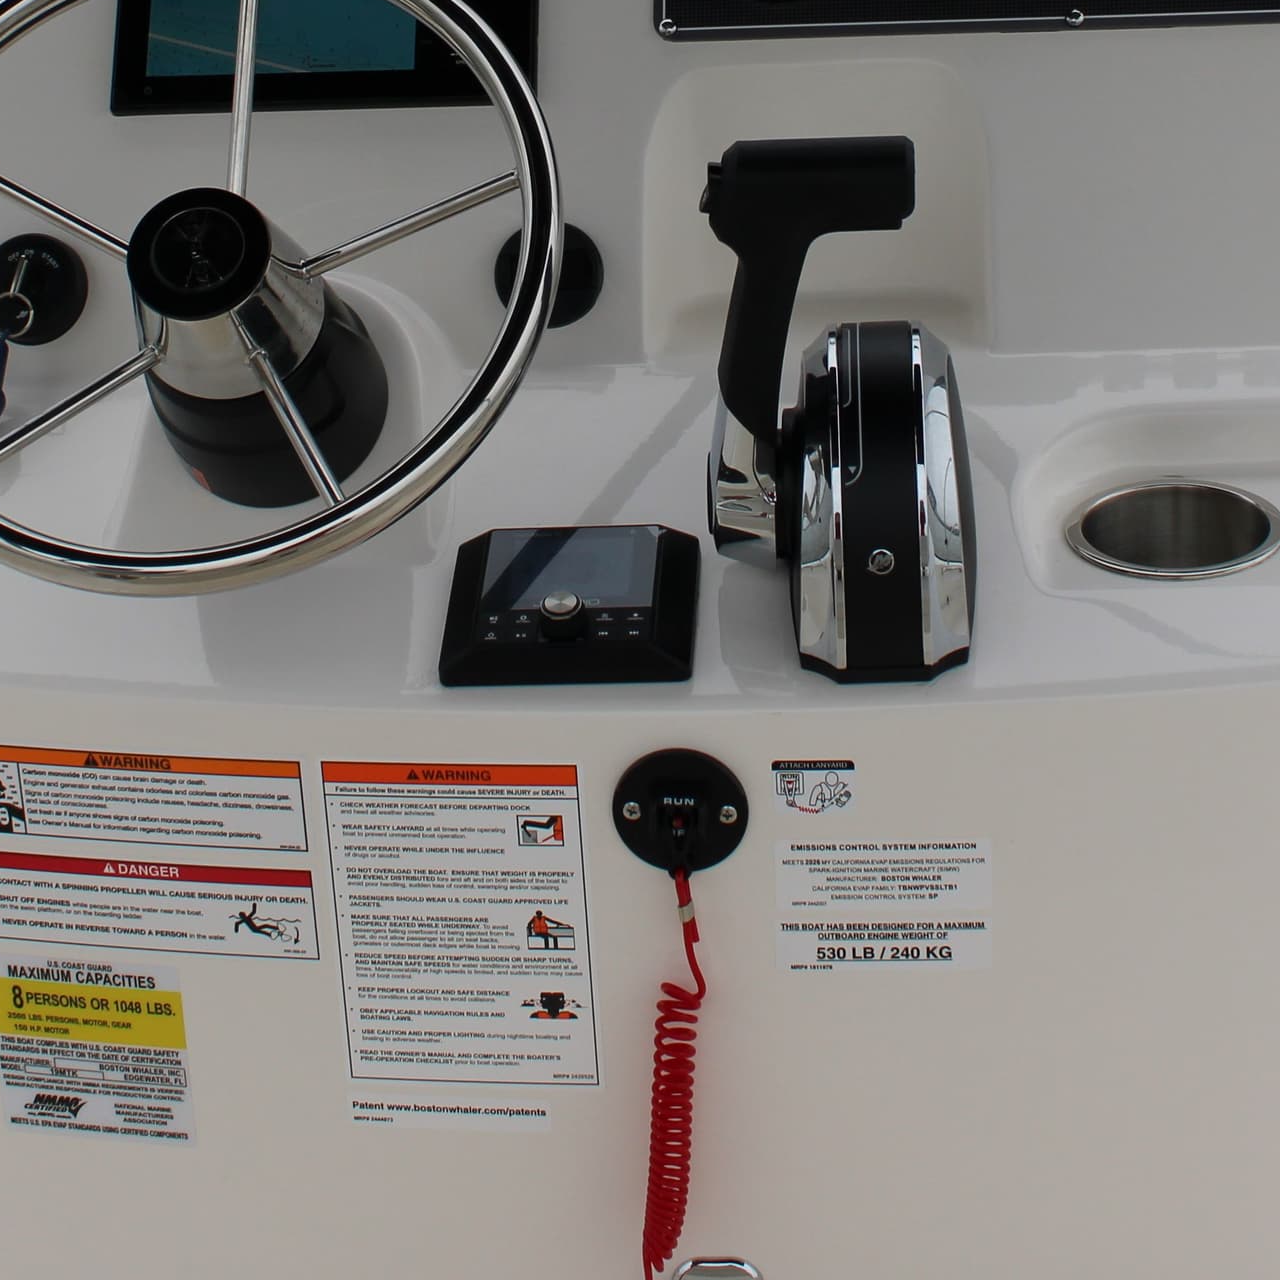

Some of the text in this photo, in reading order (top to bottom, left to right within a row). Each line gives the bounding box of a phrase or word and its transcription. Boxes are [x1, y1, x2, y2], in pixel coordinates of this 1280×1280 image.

[97, 755, 171, 771] WARNING
[421, 769, 491, 782] WARNING
[663, 796, 696, 806] RUN
[117, 863, 179, 879] DANGER
[32, 880, 53, 891] WITH
[61, 882, 99, 894] SPINNING
[100, 884, 147, 897] PROPELLER
[147, 888, 167, 898] WILL
[168, 889, 196, 900] CAUSE
[197, 890, 233, 902] SERIOUS
[234, 892, 263, 903] INJURY
[279, 895, 308, 905] DEATH.
[781, 923, 800, 931] THIS
[845, 922, 869, 930] BEEN
[870, 922, 915, 930] DESIGNED
[943, 921, 985, 929] MAXIMUM
[817, 931, 948, 940] OUTBOARD ENGINE WEIGHT OF
[816, 946, 952, 960] 530 LB / 240 KG
[61, 962, 85, 970] COAST
[86, 964, 112, 972] GUARD
[7, 965, 155, 989] MAXIMUM CAPACITIES
[12, 985, 175, 1017] 8 PERSONS OR 1048 LBS.
[1, 1036, 179, 1058] THIS BOAT COMPLIES WITH U.S. COAST GUARD SAFETY
[0, 1045, 40, 1055] STANDARDS
[49, 1049, 74, 1058] EFFECT
[87, 1052, 100, 1060] THE
[101, 1053, 119, 1061] DATE
[130, 1055, 182, 1066] CERTIFICATION
[98, 1064, 183, 1077] BOSTON WHALER, INC.
[123, 1075, 172, 1084] EDGEWATER,
[352, 1100, 547, 1116] Patent www.bostonwhaler.com/patents
